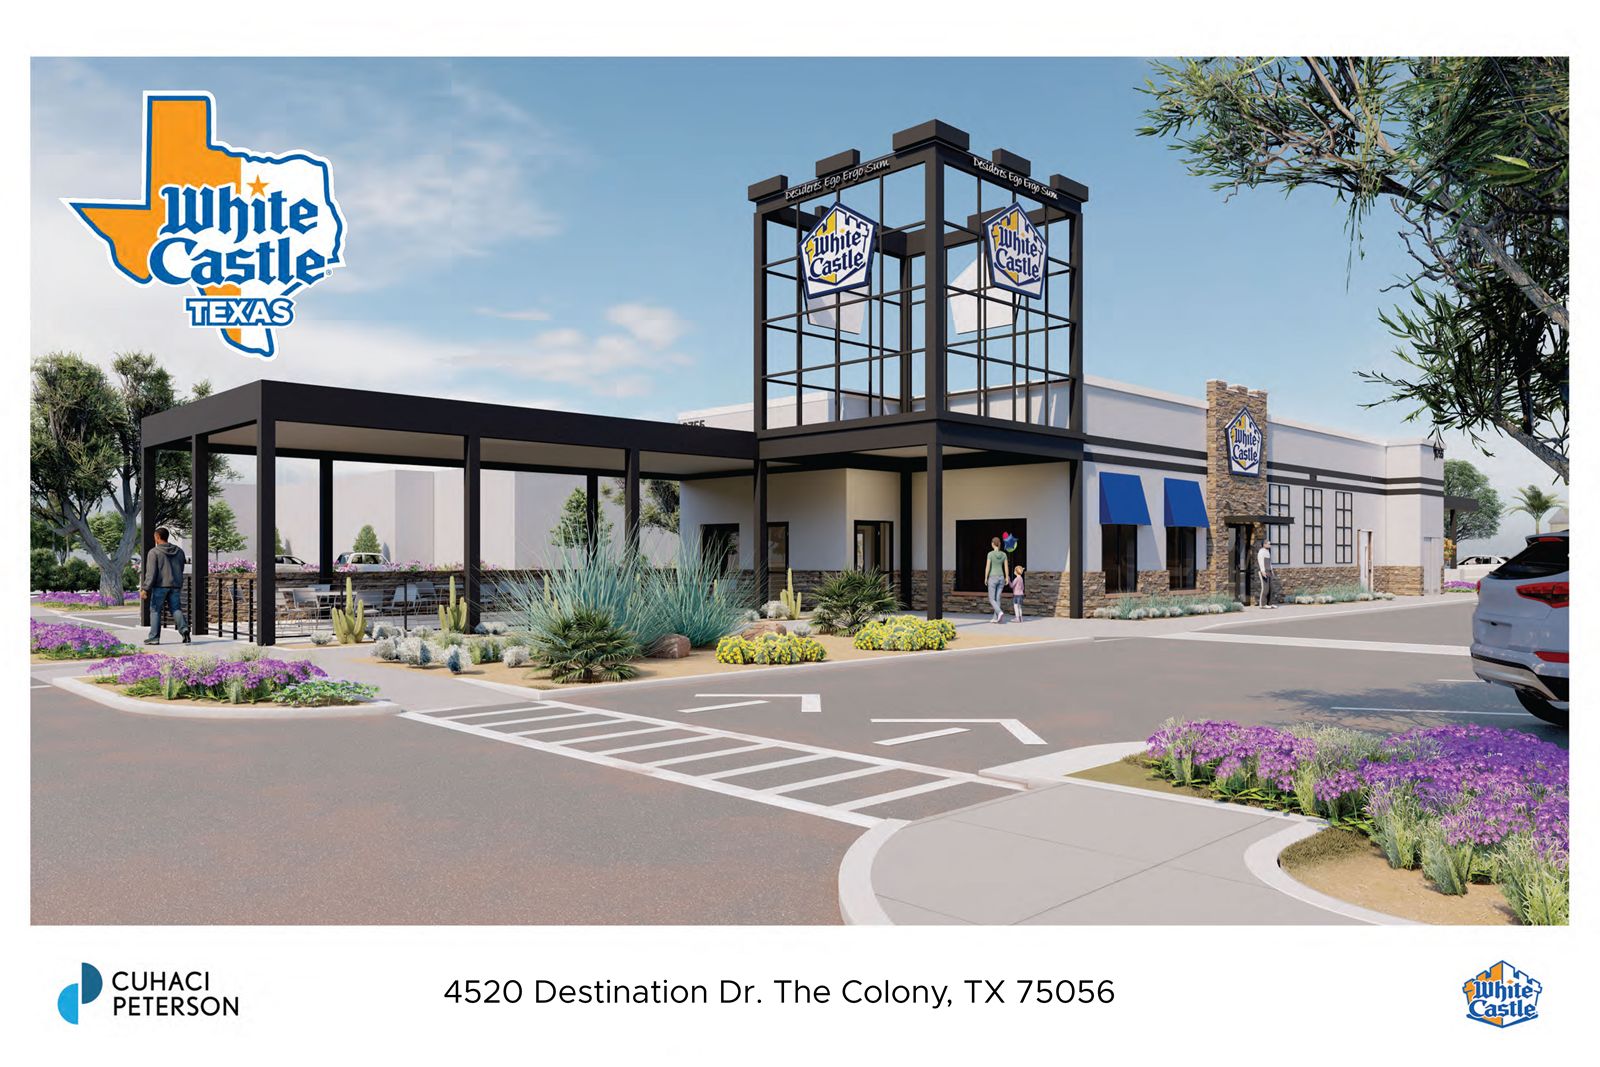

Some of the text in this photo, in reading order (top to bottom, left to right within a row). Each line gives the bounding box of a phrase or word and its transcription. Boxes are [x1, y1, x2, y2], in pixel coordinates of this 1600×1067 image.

[784, 159, 890, 200] Desideres Ego Ergo Sum
[1008, 171, 1022, 187] Ego
[1023, 178, 1040, 194] Ergo
[1040, 186, 1058, 200] Sum
[813, 229, 862, 258] White
[998, 226, 1038, 258] White
[810, 248, 864, 278] Castle
[995, 247, 1040, 278] Castle
[1234, 428, 1257, 447] White
[1232, 444, 1258, 462] Castle
